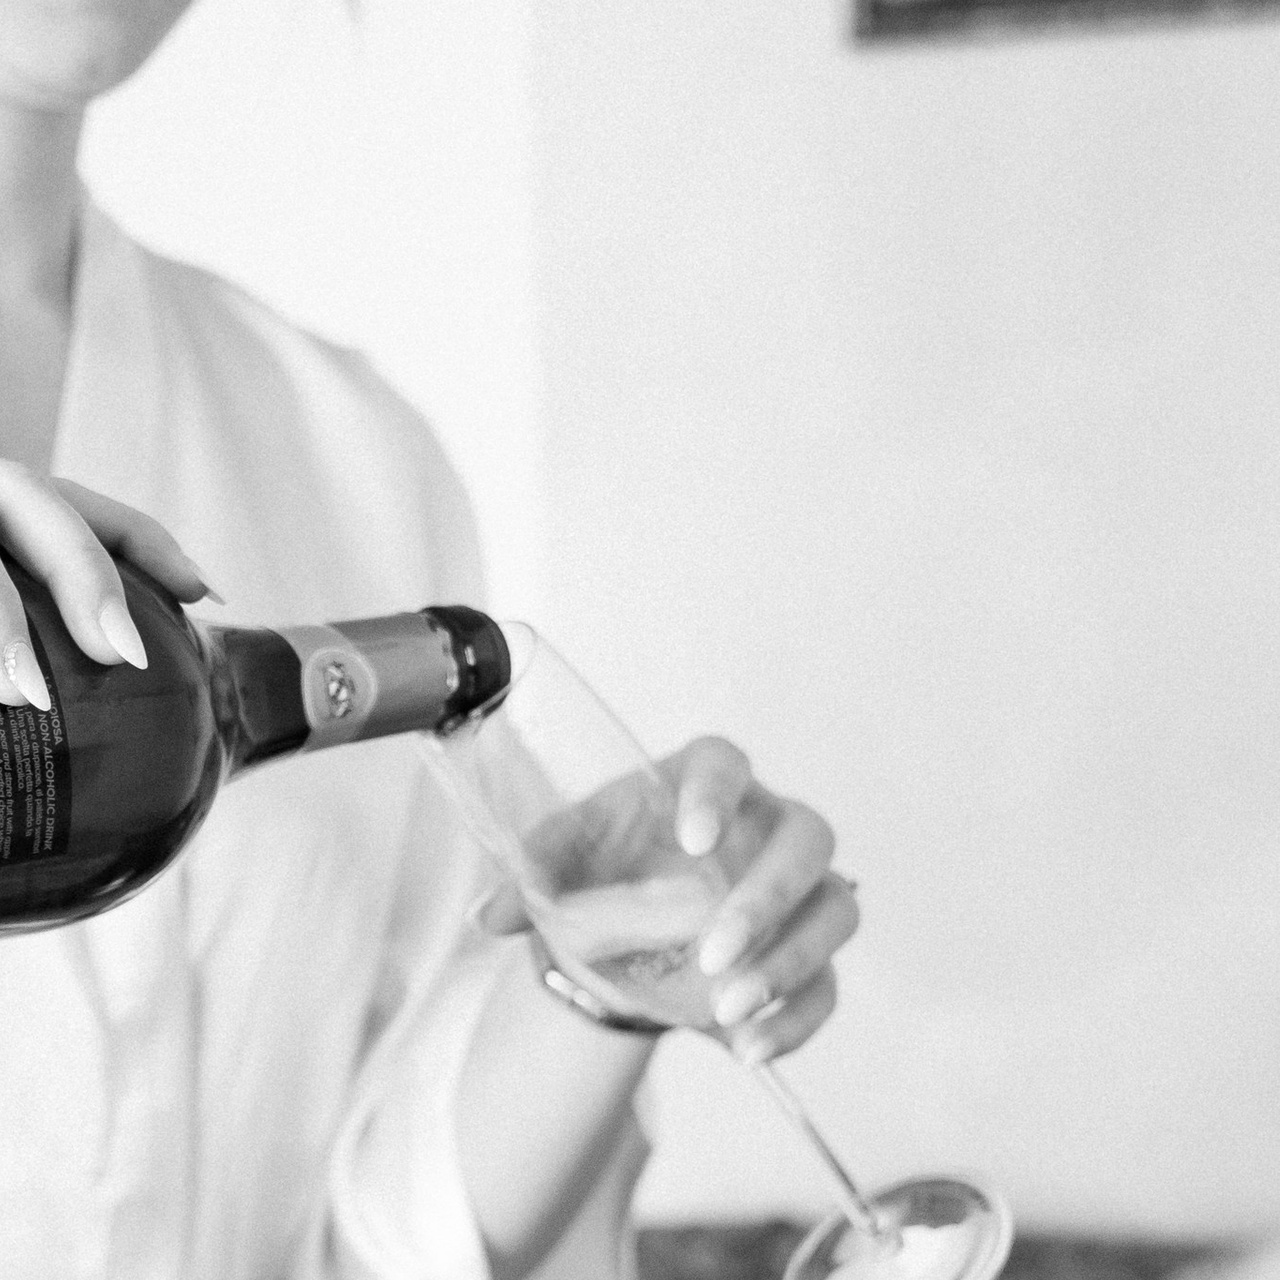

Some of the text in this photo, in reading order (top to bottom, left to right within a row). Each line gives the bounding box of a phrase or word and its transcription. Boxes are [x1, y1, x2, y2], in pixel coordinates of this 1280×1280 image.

[15, 708, 26, 727] Una
[24, 710, 35, 731] pera
[9, 718, 20, 742] drink
[19, 728, 30, 756] scelta
[2, 751, 12, 771] and
[21, 757, 33, 792] perfetta
[37, 713, 55, 851] NON-ALCOHOLIC DRINK
[24, 793, 34, 827] quando
[5, 816, 13, 834] with
